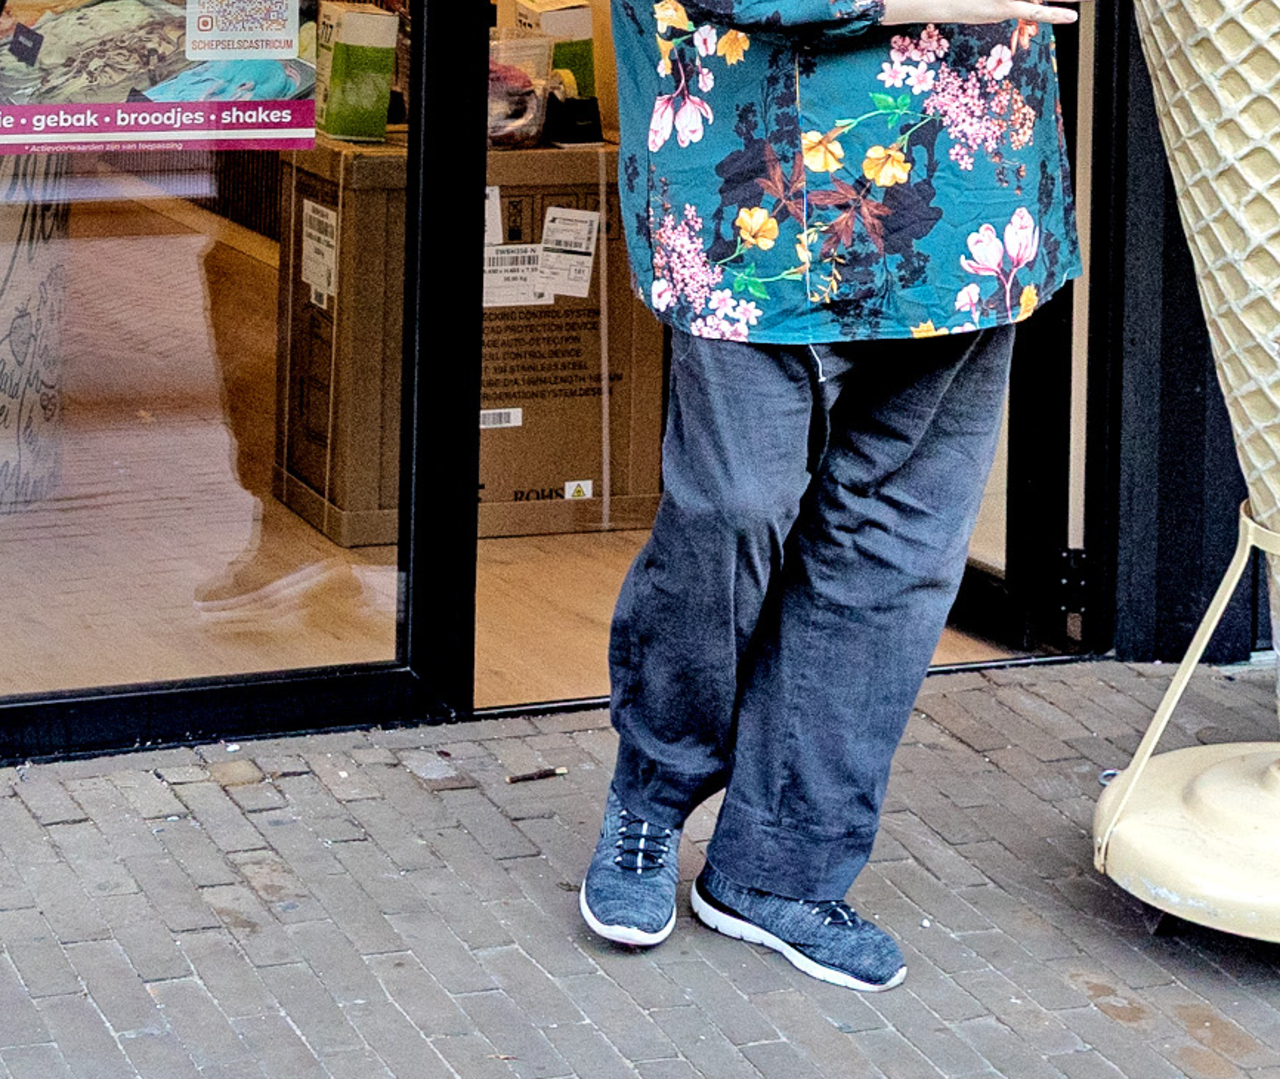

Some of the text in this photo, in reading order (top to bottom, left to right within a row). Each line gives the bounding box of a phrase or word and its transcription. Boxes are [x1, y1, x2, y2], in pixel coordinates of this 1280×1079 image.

[191, 38, 293, 50] SCHEPSELSCASTRICUM
[32, 110, 98, 131] gebak
[116, 107, 204, 128] broodjes
[221, 106, 291, 124] shakes
